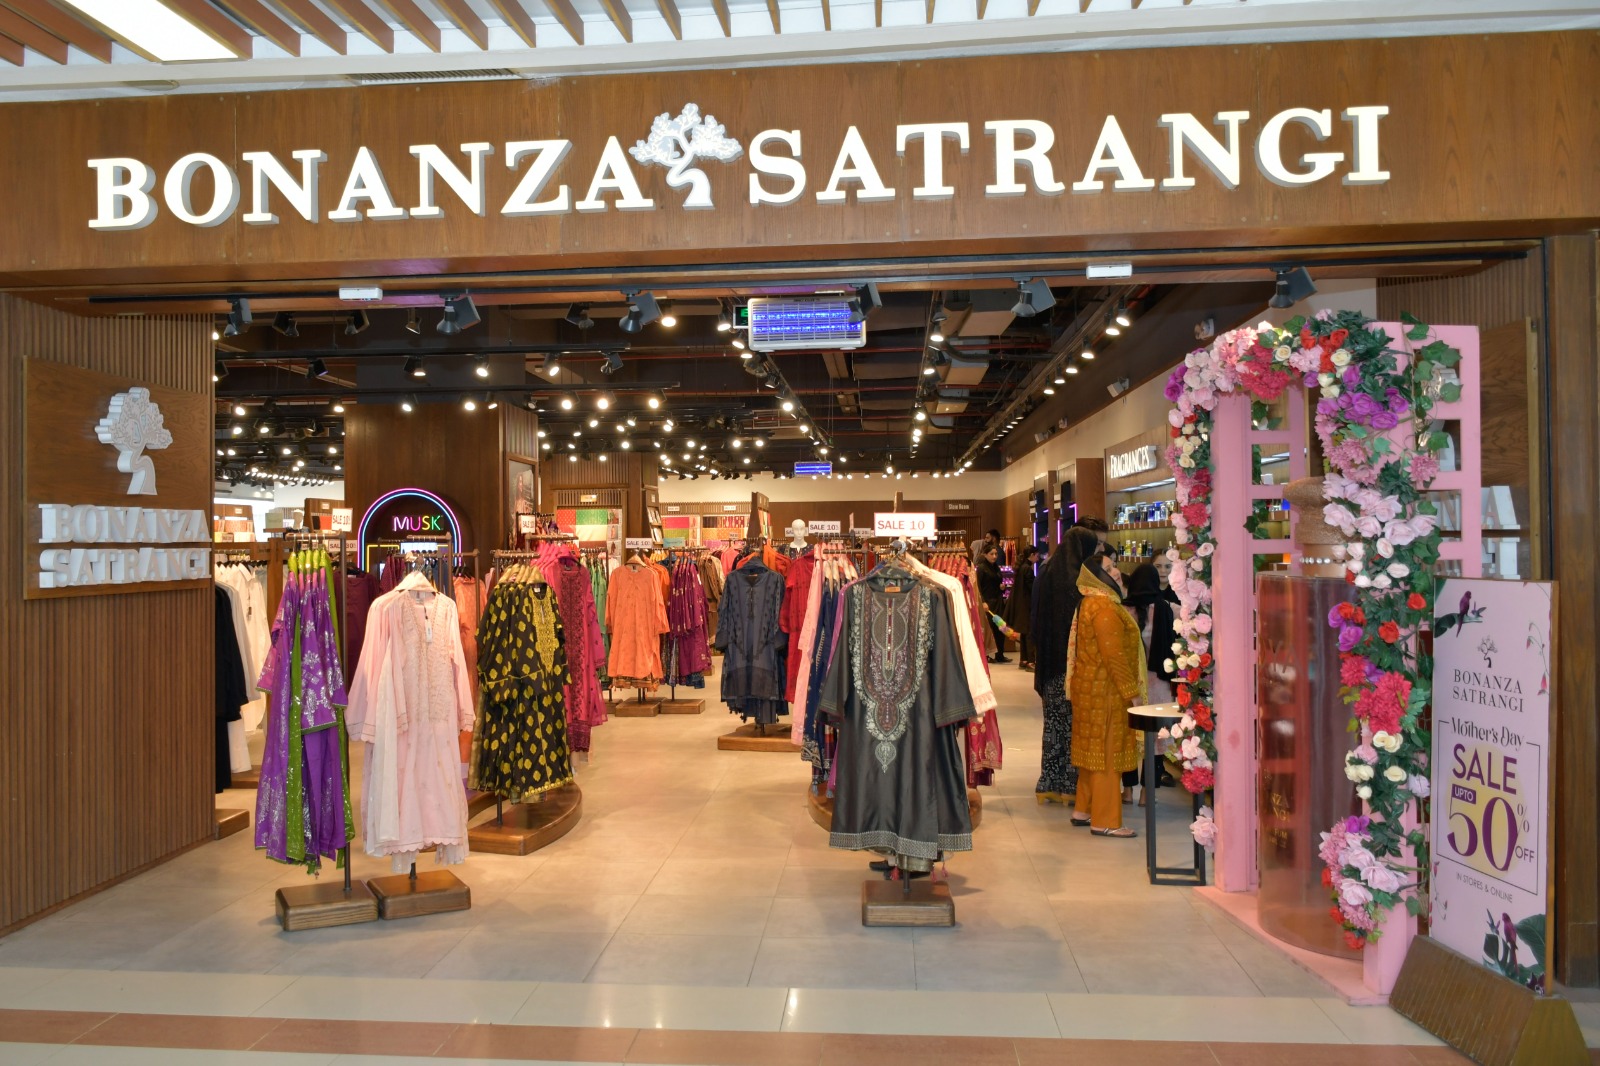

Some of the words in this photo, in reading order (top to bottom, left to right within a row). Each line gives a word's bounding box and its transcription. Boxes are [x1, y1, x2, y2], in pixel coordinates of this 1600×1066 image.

[87, 135, 655, 231] BONANZA
[747, 105, 1391, 206] SATRANGI
[1109, 445, 1156, 479] FRAGRANCES
[38, 503, 212, 544] BONANZA
[393, 515, 441, 532] MUSK
[877, 520, 905, 530] SALE
[909, 520, 925, 530] 10
[39, 547, 212, 589] SATRANGI
[1454, 668, 1523, 695] BONANZA
[1452, 685, 1524, 713] SATRANGI
[1451, 716, 1499, 744] Mother's
[1500, 725, 1525, 752] Day
[1452, 743, 1518, 795] SALE
[1454, 785, 1474, 802] UPTO
[1515, 846, 1535, 863] OFF
[1456, 872, 1463, 881] IN
[1463, 875, 1483, 892] STORES
[1484, 884, 1489, 893] &
[1490, 886, 1513, 903] ONLINE
